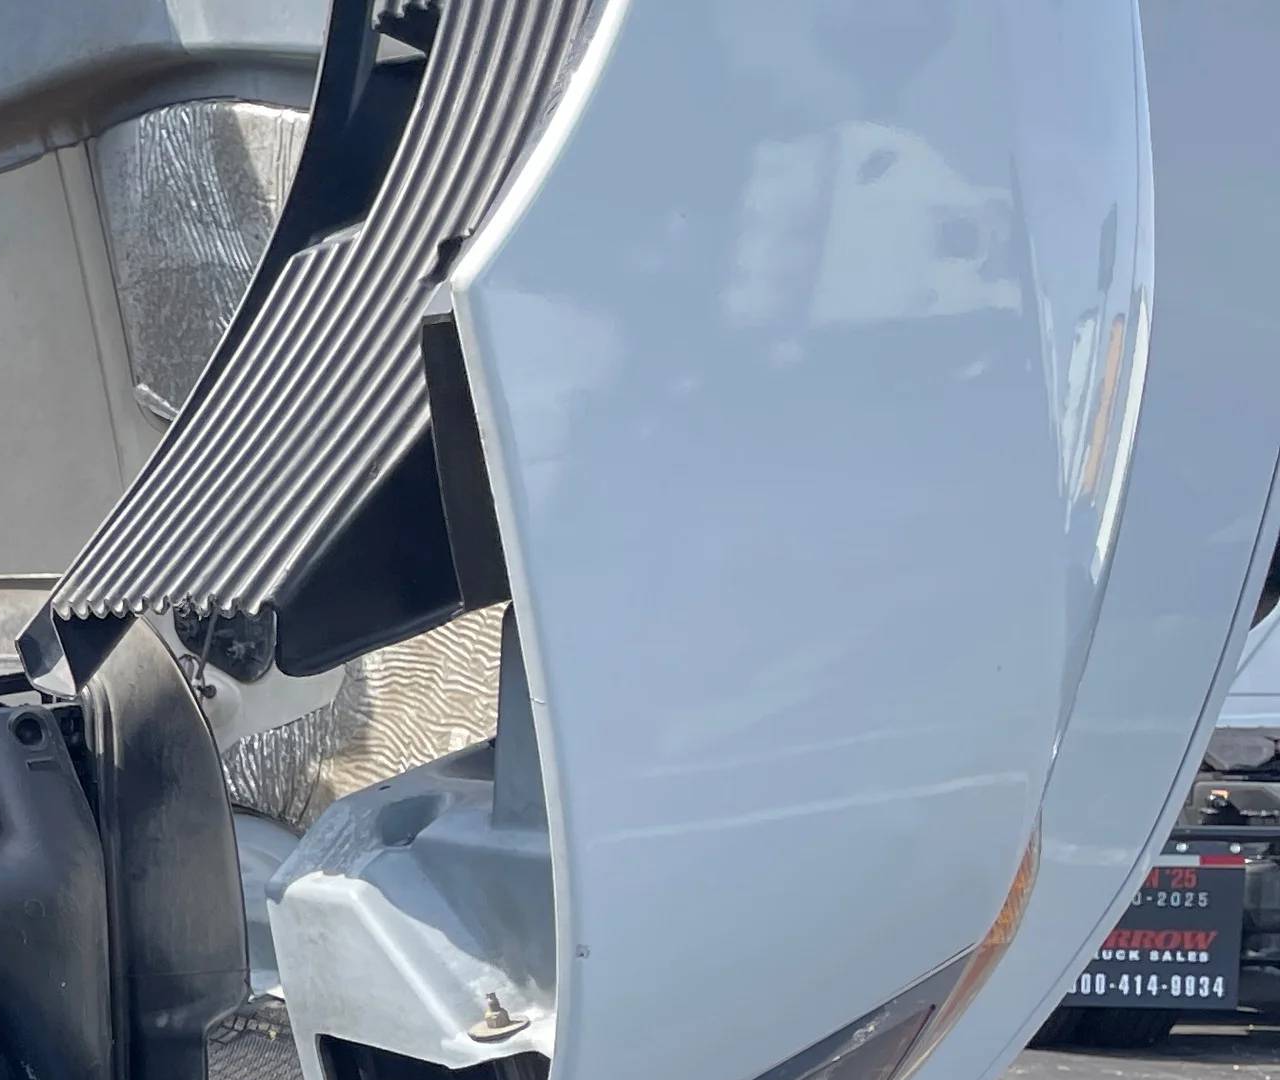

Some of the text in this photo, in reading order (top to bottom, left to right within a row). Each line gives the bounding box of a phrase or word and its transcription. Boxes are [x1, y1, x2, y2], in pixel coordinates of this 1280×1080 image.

[1103, 930, 1217, 949] RROW
[1094, 950, 1209, 962] UCK SALES
